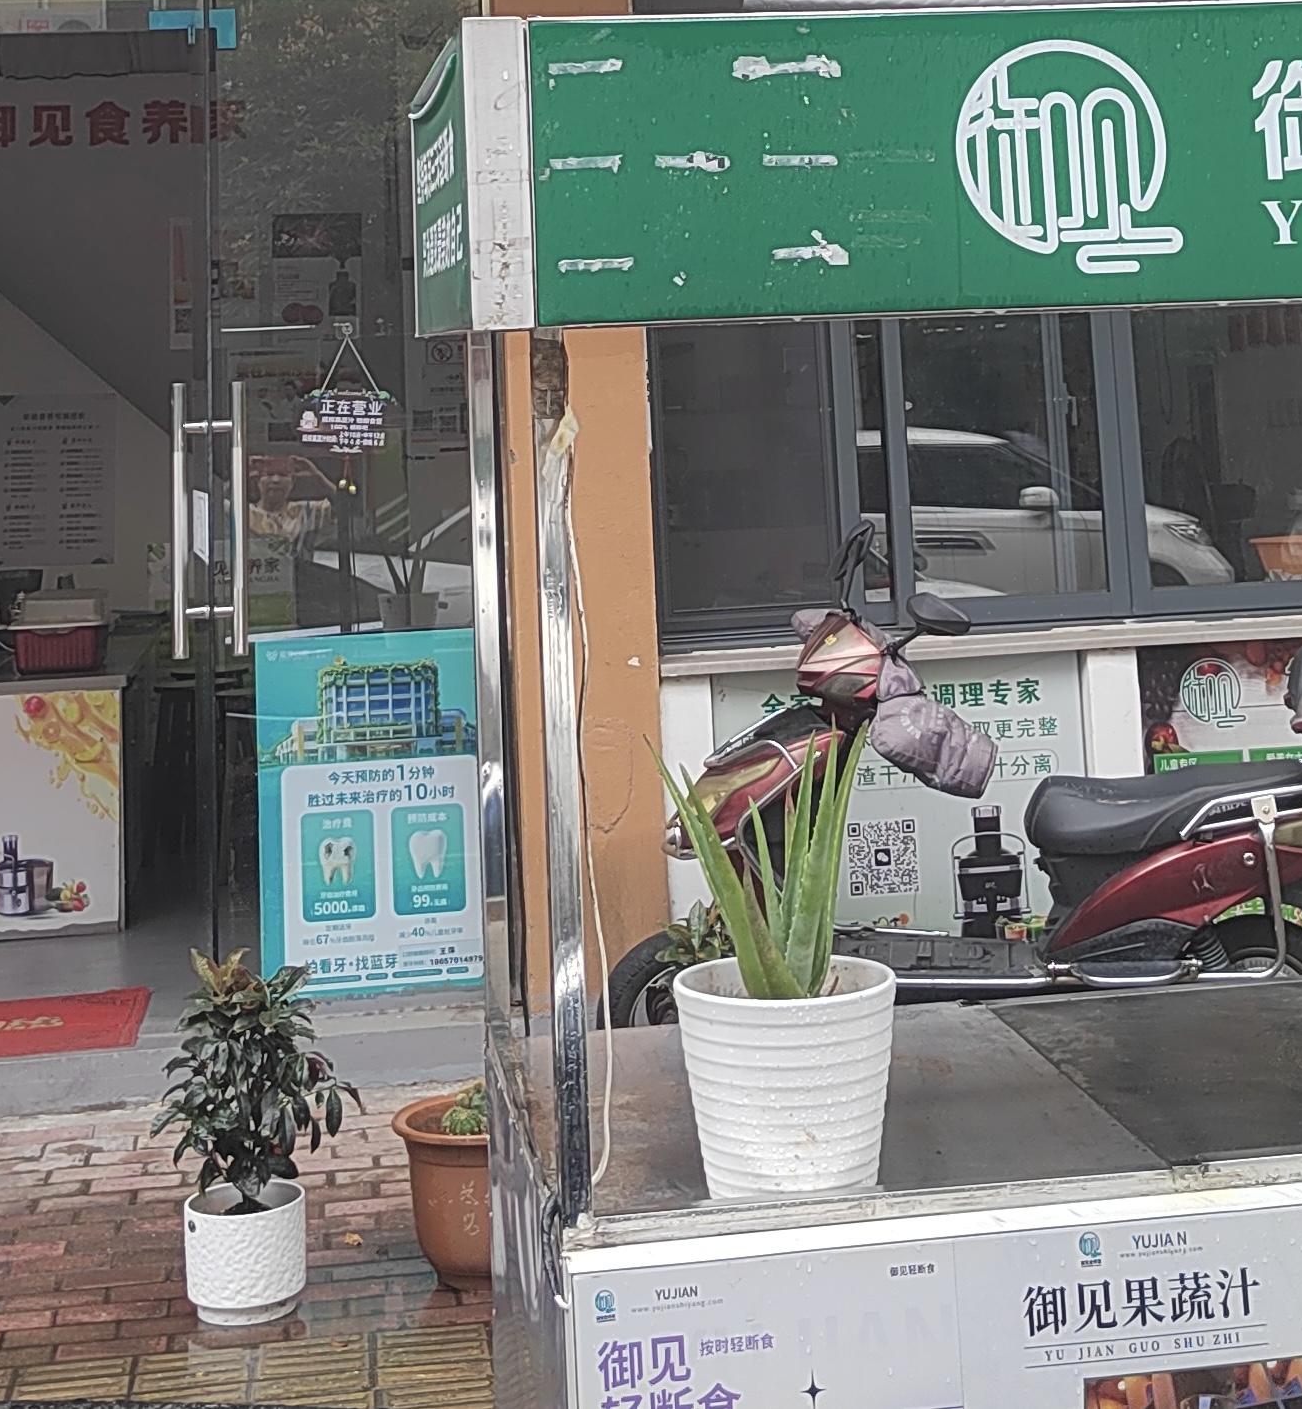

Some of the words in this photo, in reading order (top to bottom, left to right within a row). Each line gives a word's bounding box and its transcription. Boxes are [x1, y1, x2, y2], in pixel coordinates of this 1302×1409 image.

[319, 399, 383, 416] 正在营业
[328, 764, 435, 786] 今天预防的1分钟
[307, 782, 455, 808] 胜过未来治疗的10小时
[889, 1262, 936, 1278] 御见轻断食
[654, 1286, 699, 1302] YUJIAN
[1022, 1267, 1261, 1338] 御见果蔬汁
[699, 1333, 775, 1358] 按时轻断食
[1044, 1348, 1065, 1362] YU
[1078, 1345, 1115, 1360] JIAN
[1129, 1340, 1160, 1354] GUO
[1174, 1334, 1205, 1349] SHU
[1212, 1332, 1240, 1345] ZHI
[598, 1334, 692, 1392] 御见
